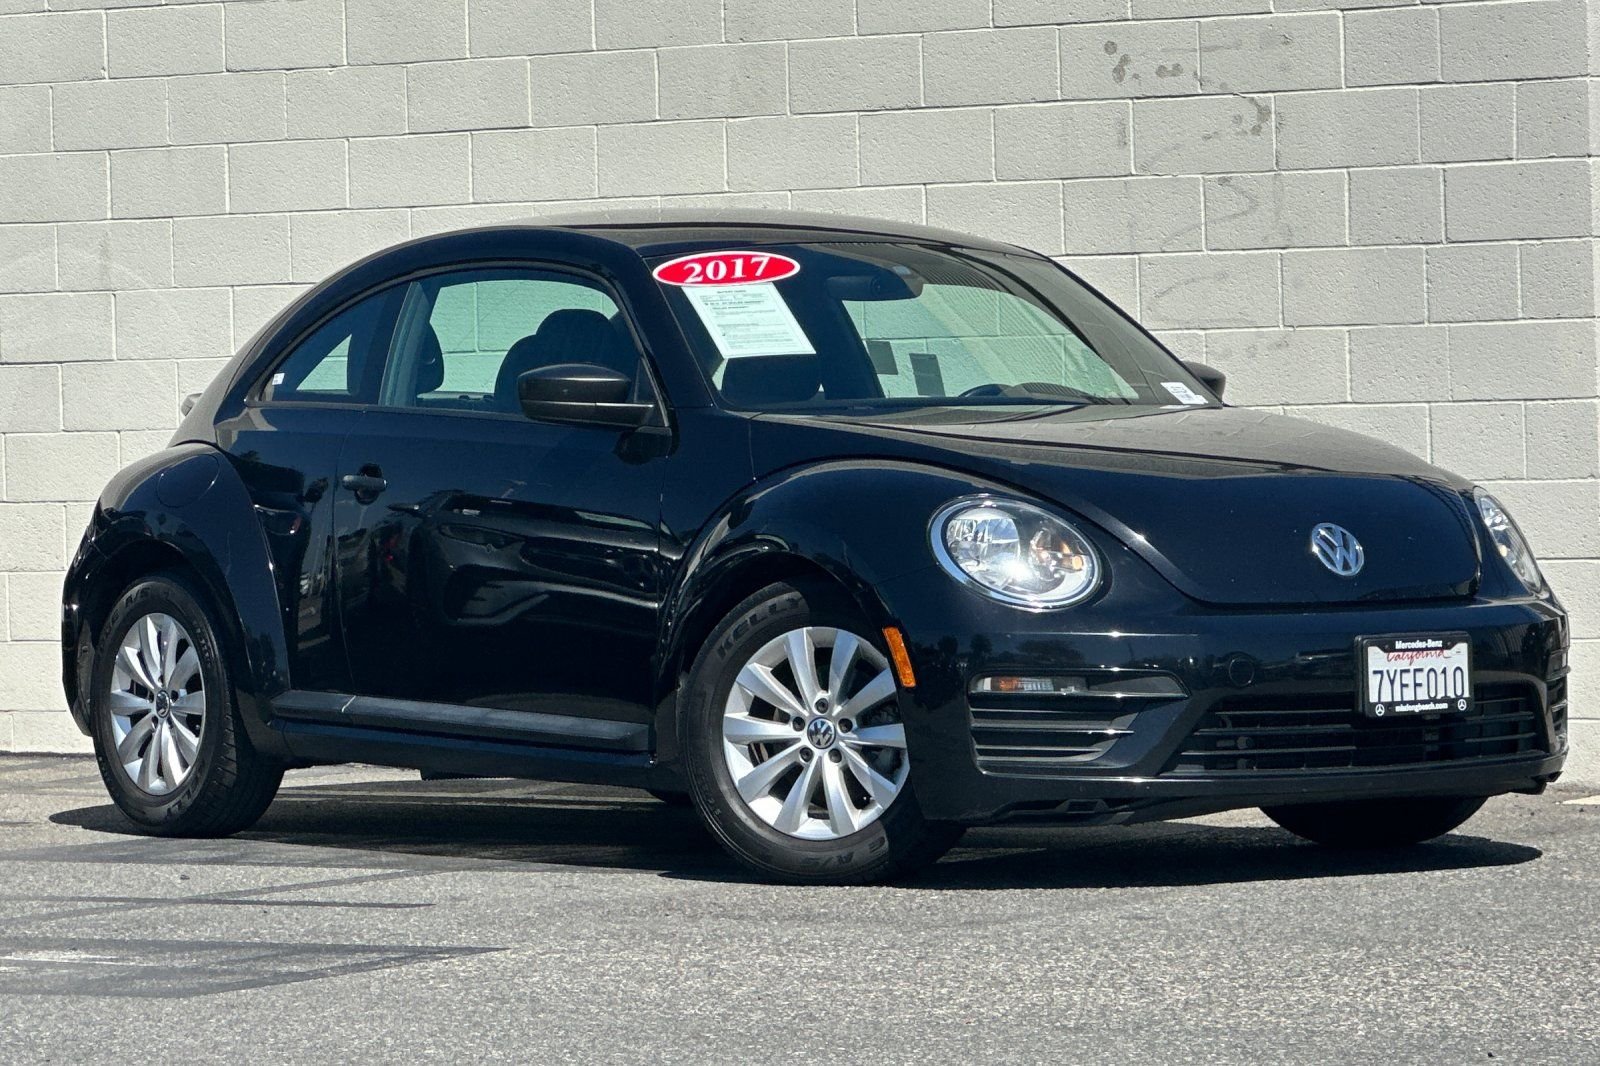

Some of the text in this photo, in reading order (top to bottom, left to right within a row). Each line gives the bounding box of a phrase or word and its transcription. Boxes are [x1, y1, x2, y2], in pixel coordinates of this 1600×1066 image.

[683, 257, 770, 283] 2017
[716, 597, 805, 660] KELLY
[1395, 639, 1442, 650] Mercedes-Benz
[1387, 650, 1451, 666] California
[1372, 666, 1464, 703] 7YFF010
